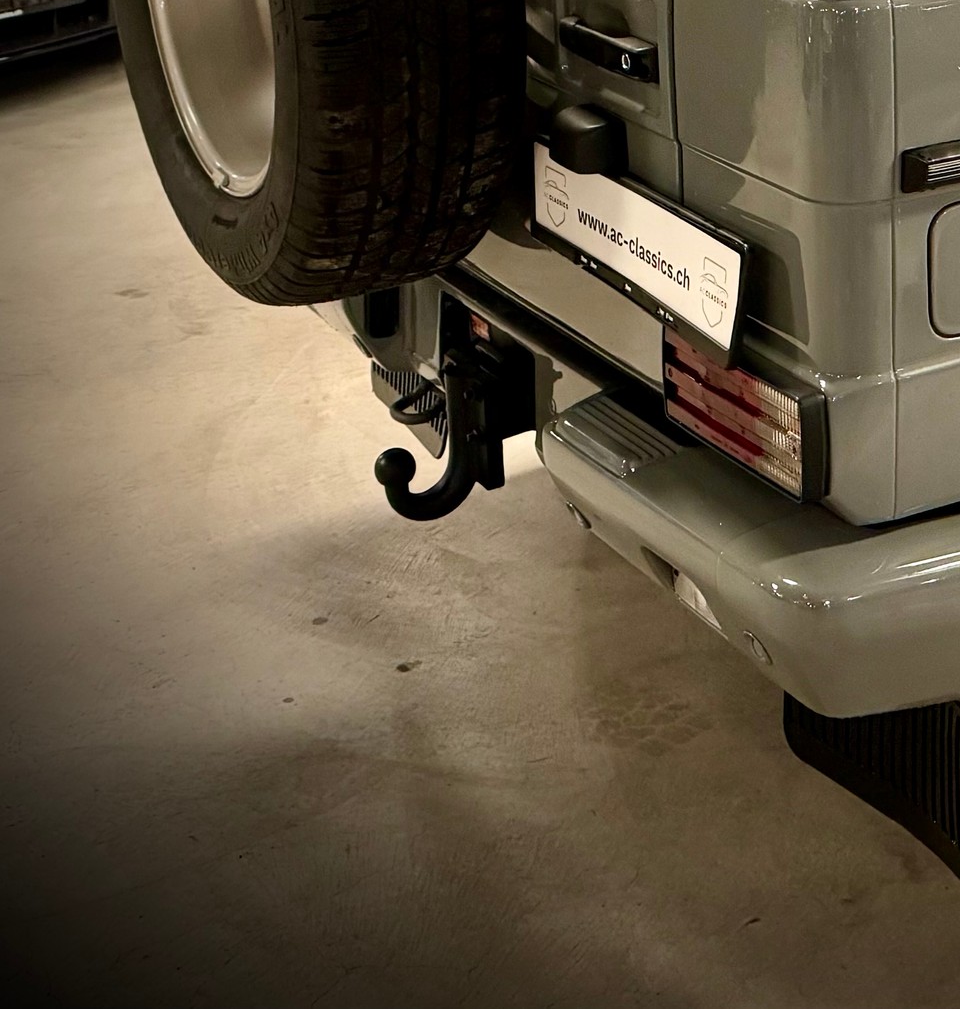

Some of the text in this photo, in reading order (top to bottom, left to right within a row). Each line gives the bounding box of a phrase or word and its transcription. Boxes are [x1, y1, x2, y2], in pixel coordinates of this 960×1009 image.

[549, 194, 569, 210] CLASSICS
[577, 208, 690, 291] www.ac-classics.ch
[705, 290, 727, 309] CLASSICS
